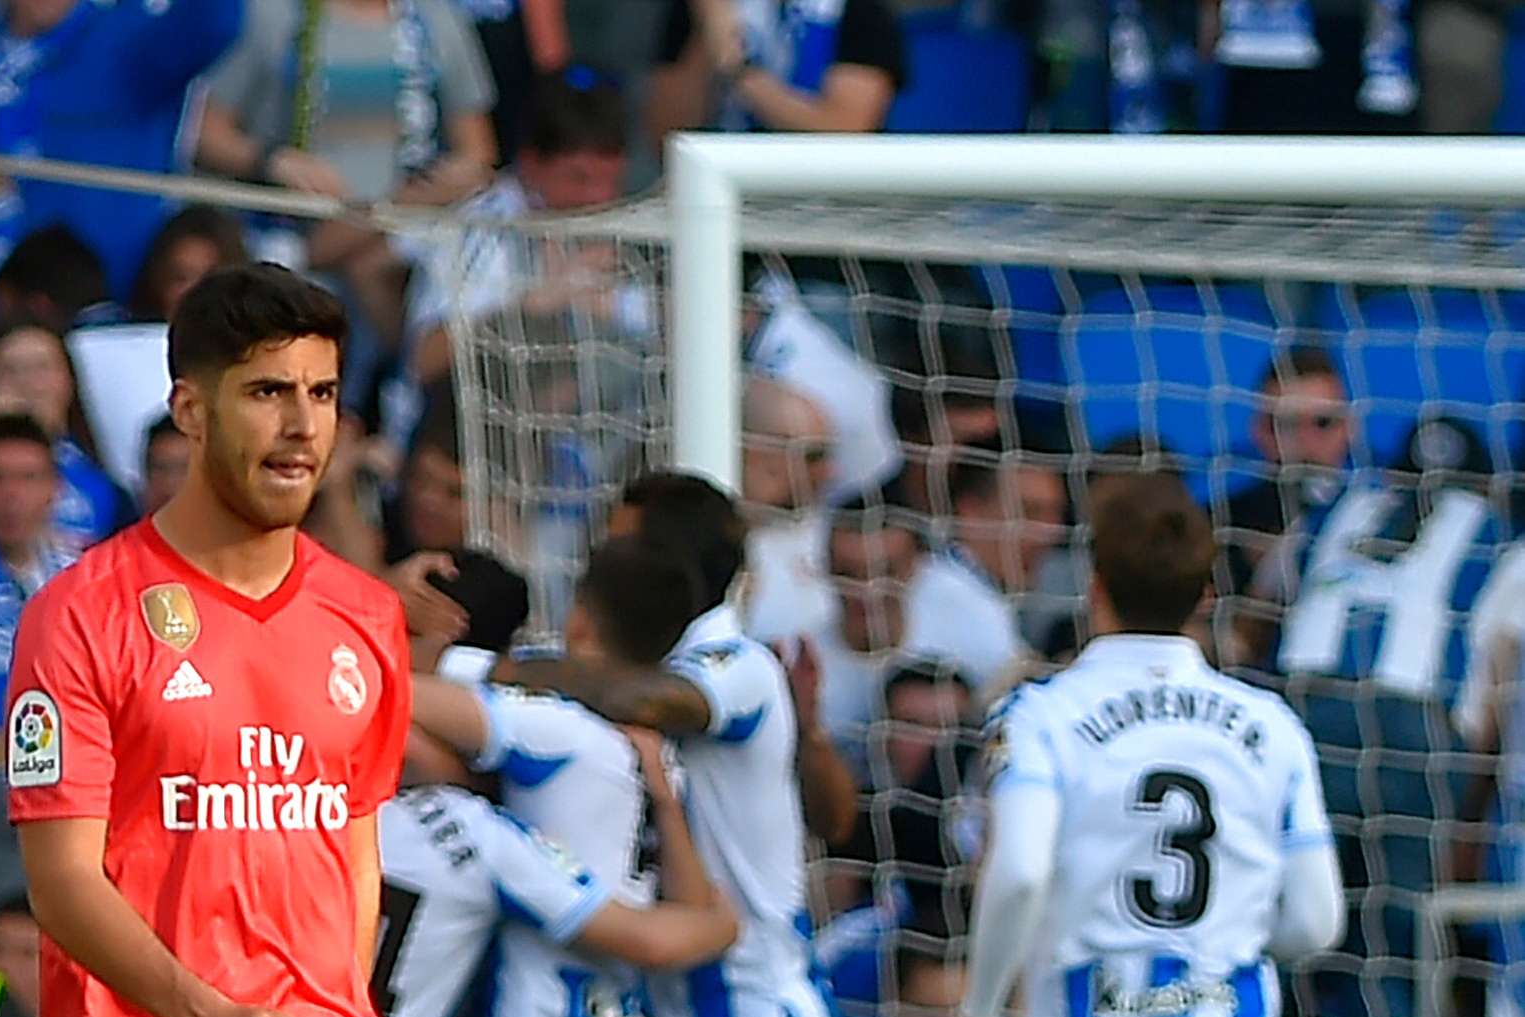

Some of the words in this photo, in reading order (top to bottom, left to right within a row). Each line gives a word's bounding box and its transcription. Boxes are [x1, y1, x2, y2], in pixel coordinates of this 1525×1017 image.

[12, 756, 55, 774] LaLiga
[239, 724, 305, 777] Fly
[1122, 766, 1217, 930] 3
